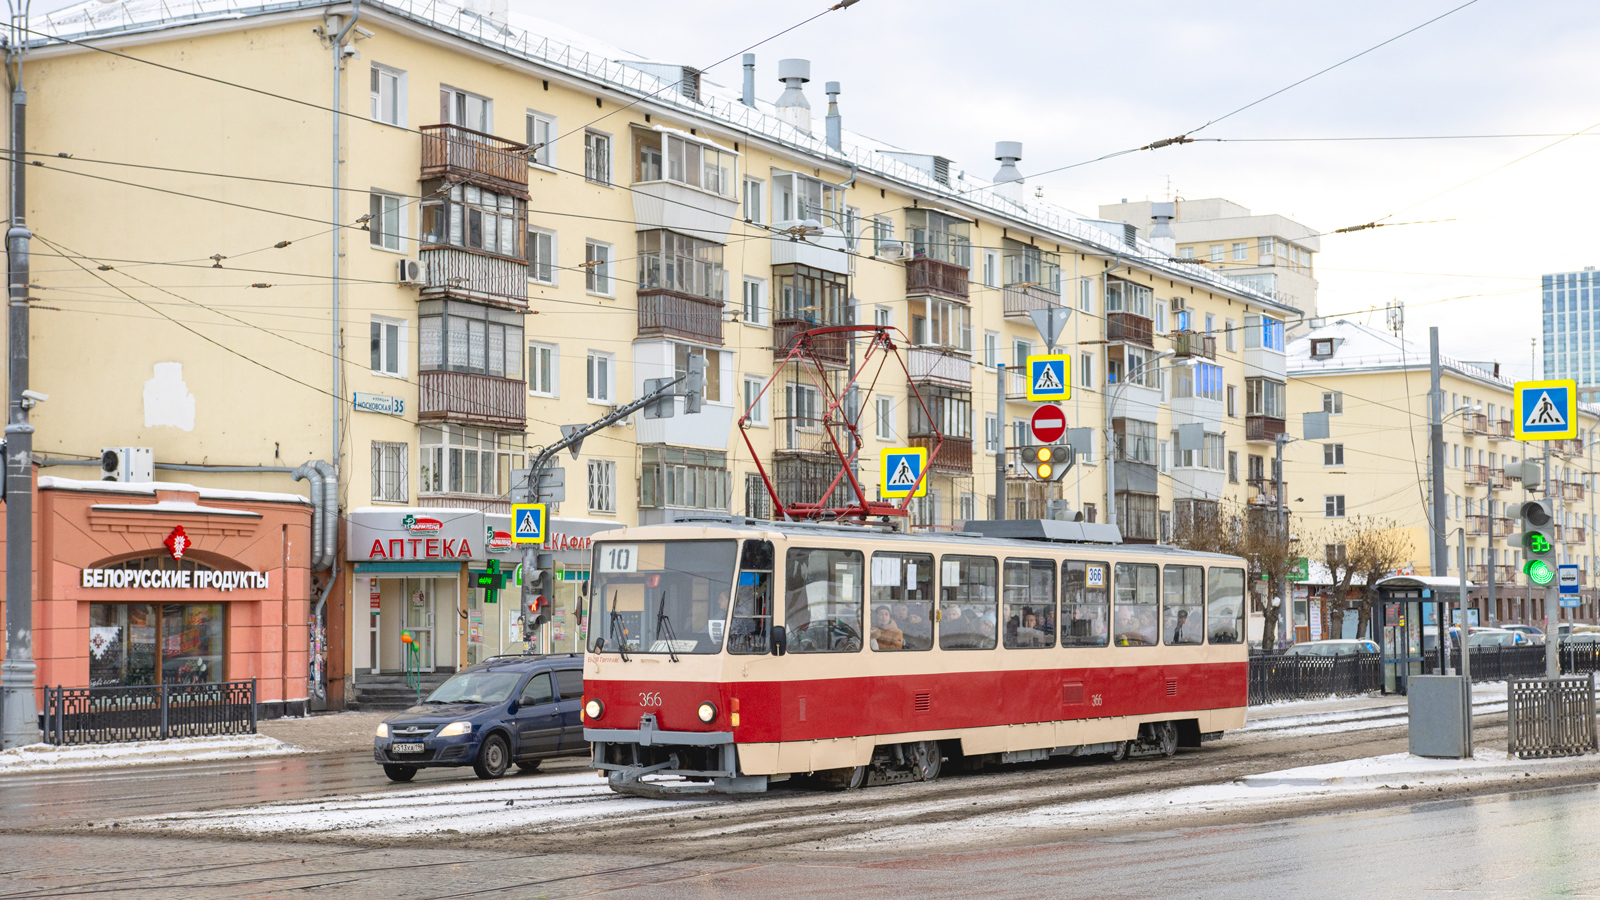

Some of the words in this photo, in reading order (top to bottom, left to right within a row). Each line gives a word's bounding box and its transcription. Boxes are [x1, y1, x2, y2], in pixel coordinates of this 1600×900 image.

[358, 401, 391, 411] МОСКОВСКАЯ
[394, 400, 404, 413] 35
[369, 538, 472, 558] АПТЕКА
[1531, 534, 1551, 553] 35
[609, 548, 630, 570] 10
[82, 568, 191, 588] БЕЛОРУССКИЕ
[193, 570, 269, 592] ПРОДУКТЫ
[1089, 568, 1102, 581] 366
[639, 692, 662, 707] 366
[1091, 694, 1102, 707] 366
